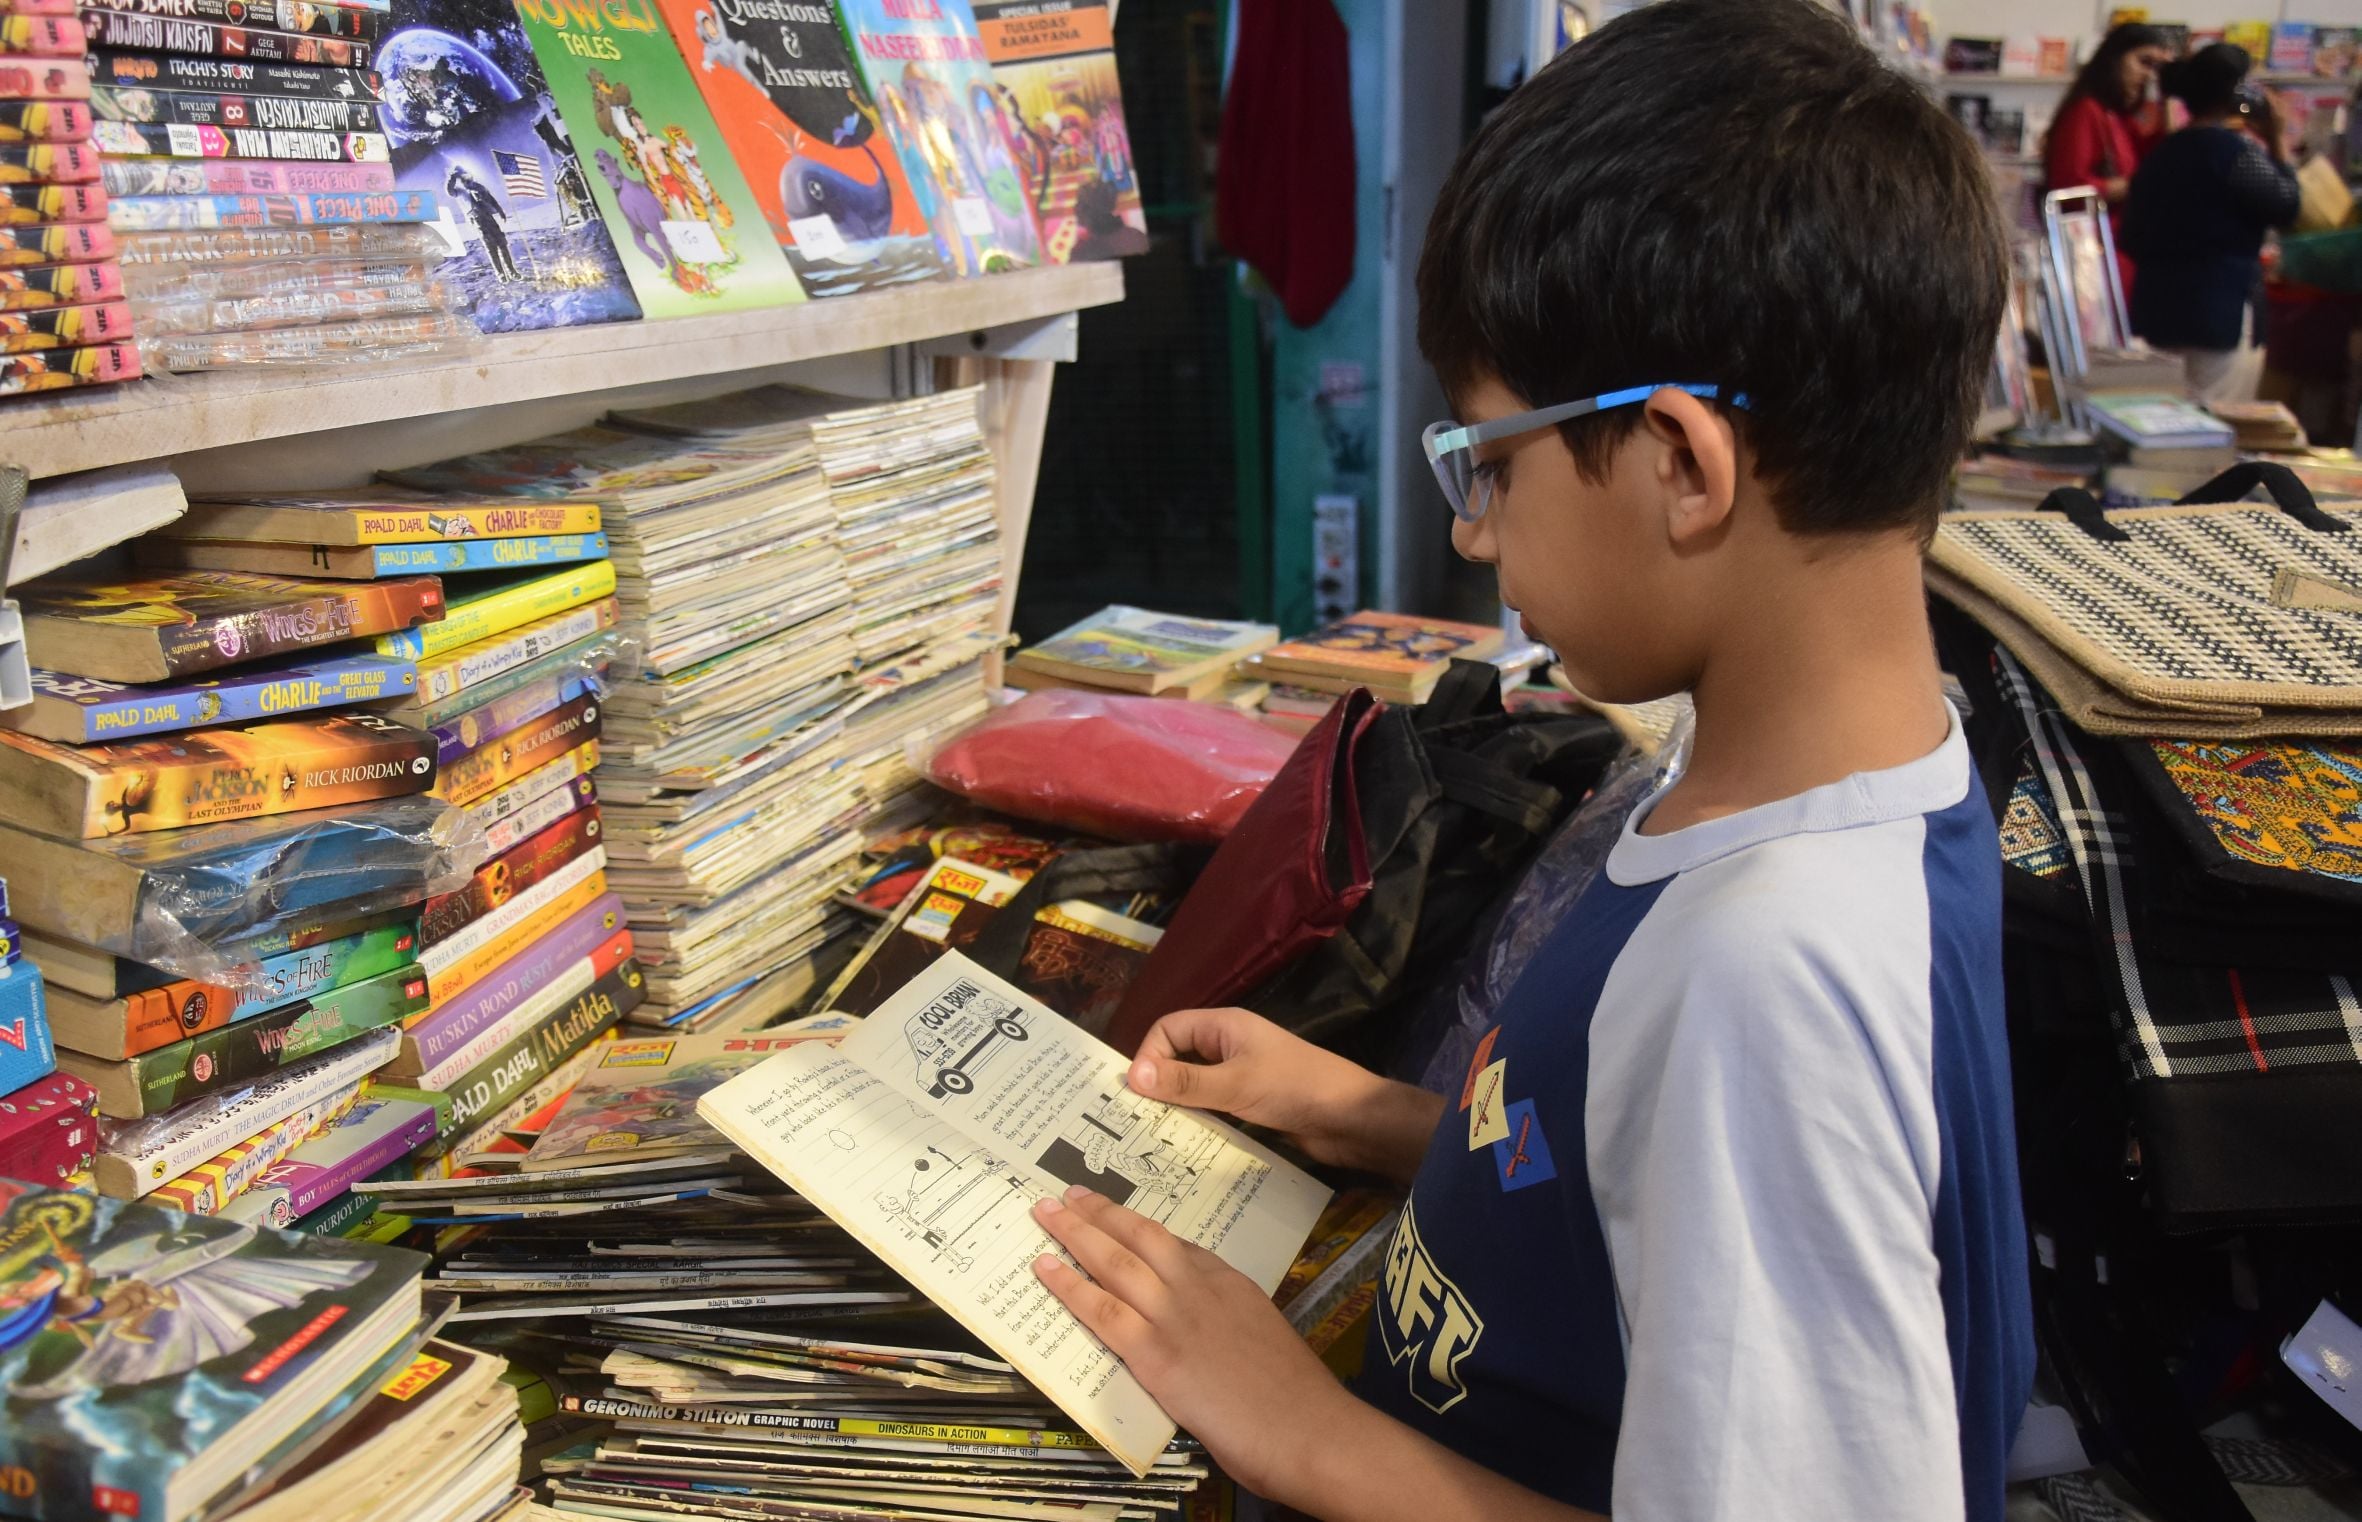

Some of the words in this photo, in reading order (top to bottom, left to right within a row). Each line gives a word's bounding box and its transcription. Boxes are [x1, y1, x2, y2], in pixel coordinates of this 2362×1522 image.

[107, 13, 163, 48] JUJUTSU
[166, 22, 213, 53] KAISEN
[226, 36, 244, 51] 7
[258, 39, 274, 48] GEGE
[558, 31, 622, 61] TALES
[999, 30, 1081, 48] RAMAYANA
[250, 48, 281, 59] AKUTAMI
[170, 59, 218, 78] ITACHI'S
[221, 63, 254, 80] STORY
[760, 51, 850, 87] Answers
[235, 129, 267, 157] MAN
[316, 198, 362, 220] PIECE
[364, 196, 398, 219] ONE
[120, 235, 223, 265] ATTACK
[365, 518, 395, 534] ROALD
[399, 518, 424, 533] DAHL
[486, 511, 528, 533] CHARLIE
[379, 551, 409, 566] ROALD
[412, 550, 437, 565] DAHL
[493, 539, 538, 563] CHARLIE
[324, 598, 364, 630] FIRE
[311, 631, 335, 642] BRIGHTEST
[336, 628, 350, 637] NIGHT
[525, 636, 536, 648] DOG
[339, 672, 362, 685] GREAT
[364, 670, 386, 683] GLASS
[260, 681, 321, 712] CHARLIE
[346, 685, 380, 699] ELEVATOR
[95, 709, 140, 732] ROALD
[143, 704, 180, 725] DAHL
[516, 738, 539, 757] RICK
[539, 715, 581, 745] RIORDAN
[305, 769, 338, 788] RICK
[342, 761, 405, 783] RIORDAN
[188, 809, 212, 819] LAST
[214, 802, 263, 816] OLYMPIAN
[514, 863, 535, 881] RICK
[298, 953, 334, 988] FIRE
[294, 984, 318, 996] KINGDOM
[427, 1010, 478, 1055] RUSKIN
[479, 982, 518, 1019] BOND
[520, 958, 551, 992] RUSTY
[919, 1001, 955, 1030] COOL
[943, 981, 981, 1010] BRIAN
[253, 1019, 302, 1055] WINGS
[288, 1041, 305, 1053] MOON
[492, 1047, 539, 1091] DAHL
[542, 993, 613, 1061] Matilda
[431, 1055, 472, 1090] SUDHA
[474, 1025, 513, 1057] MURTY
[147, 1071, 186, 1090] SUTHERLAND
[171, 1146, 201, 1166] SUDHA
[202, 1130, 229, 1151] MURTY
[233, 1119, 251, 1132] THE
[253, 1103, 280, 1127] MAGIC
[281, 1093, 305, 1115] DRUM
[306, 1086, 318, 1097] and
[319, 1077, 336, 1093] Other
[336, 1065, 362, 1084] Favourite
[363, 1054, 382, 1069] Stories
[225, 1168, 244, 1190] Diary
[277, 1132, 286, 1146] Kid
[298, 1190, 317, 1208] BOY
[319, 1178, 339, 1196] TALES
[316, 1204, 353, 1237] DURJOY
[583, 1399, 677, 1420] GERONIMO
[683, 1409, 750, 1426] STILTON
[753, 1415, 800, 1427] GRAPHIC
[803, 1416, 837, 1430] NOVEL
[878, 1423, 935, 1437] DINOSAURS
[937, 1425, 948, 1438] IN
[950, 1426, 987, 1440] ACTION
